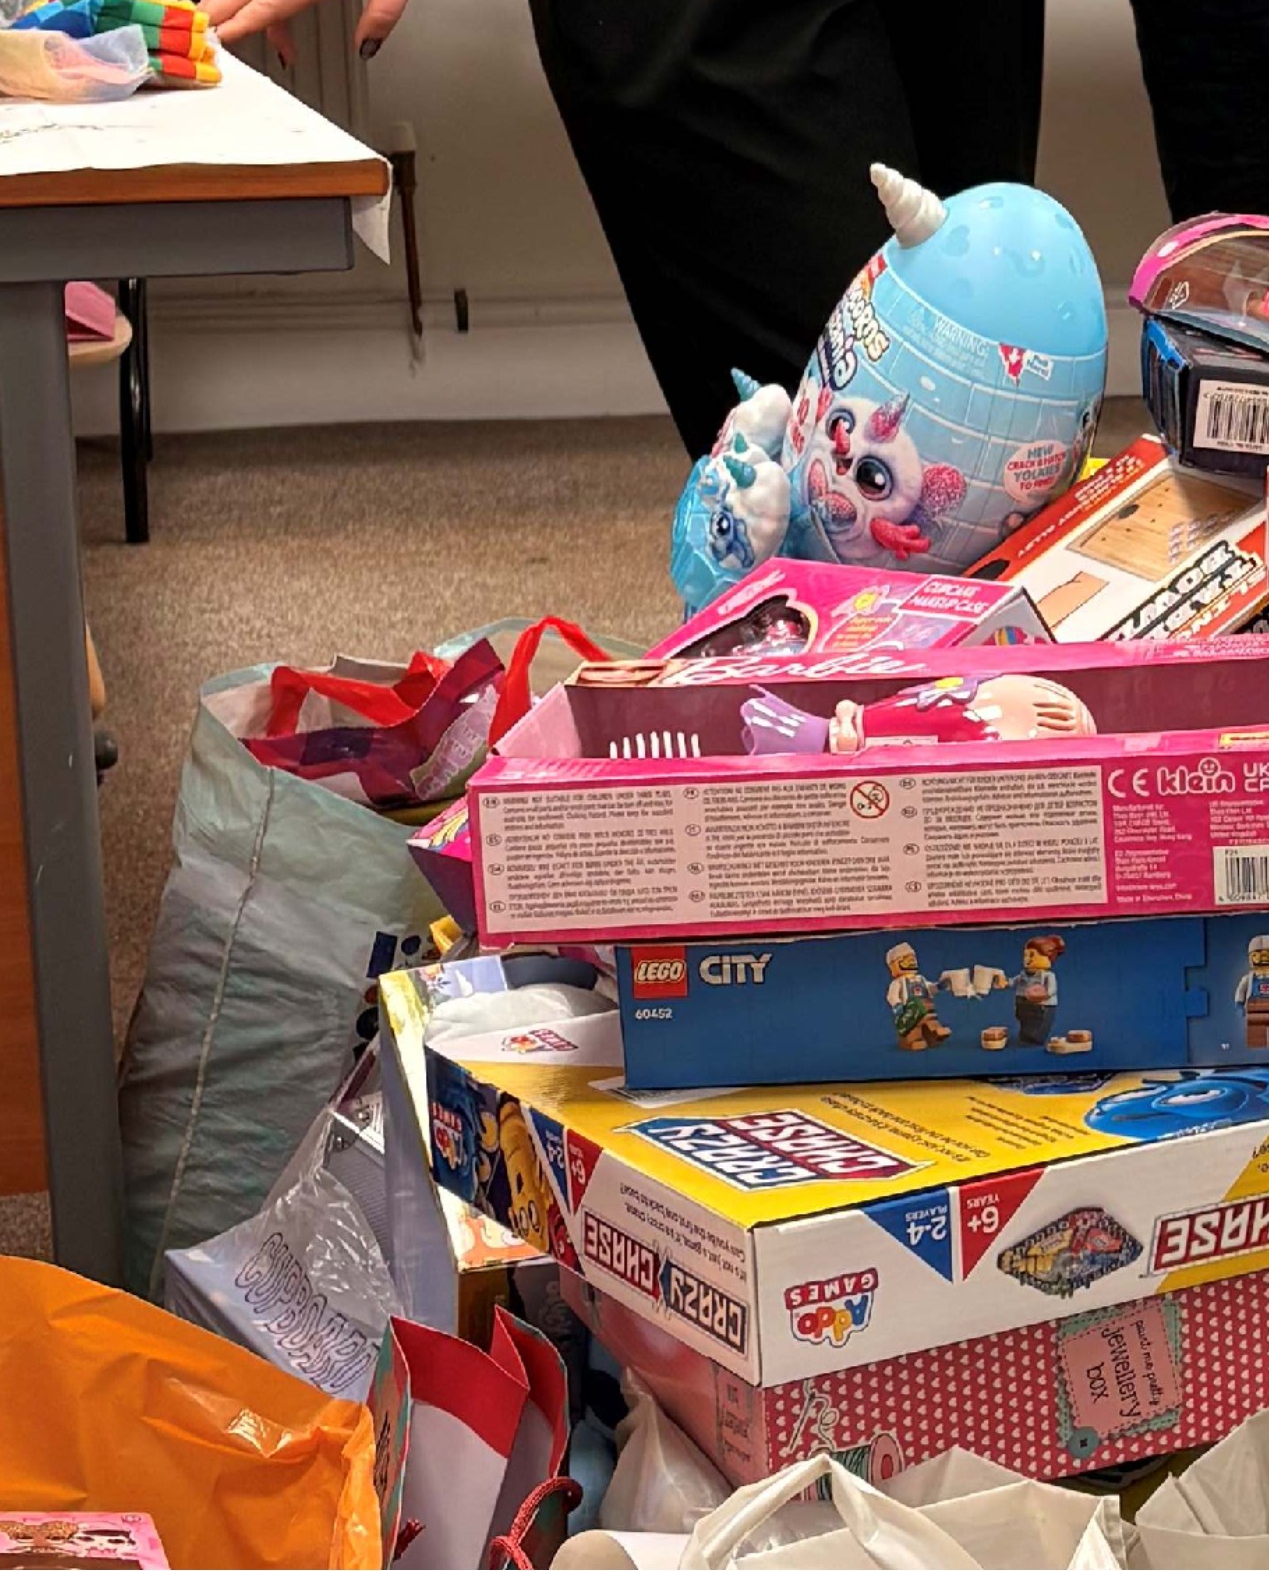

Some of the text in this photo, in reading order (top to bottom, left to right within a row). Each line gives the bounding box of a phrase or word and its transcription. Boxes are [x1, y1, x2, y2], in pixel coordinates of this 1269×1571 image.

[662, 651, 927, 687] Barbie
[1157, 757, 1235, 795] klein
[636, 953, 773, 985] LEGO CITY
[635, 1008, 673, 1020] 60452
[647, 1123, 818, 1185] CRAZY
[728, 1114, 898, 1174] CHASE
[905, 1204, 947, 1221] PLAYERS
[967, 1192, 1000, 1209] YEARS
[967, 1207, 999, 1233] 6+
[584, 1215, 654, 1292] CHASE
[670, 1267, 740, 1345] CRAZY
[790, 1274, 874, 1307] GAMES
[797, 1295, 868, 1342] Addo
[1102, 1327, 1141, 1417] jewellery
[1144, 1352, 1153, 1370] me
[1087, 1362, 1109, 1403] box
[1143, 1373, 1164, 1405] pretty
